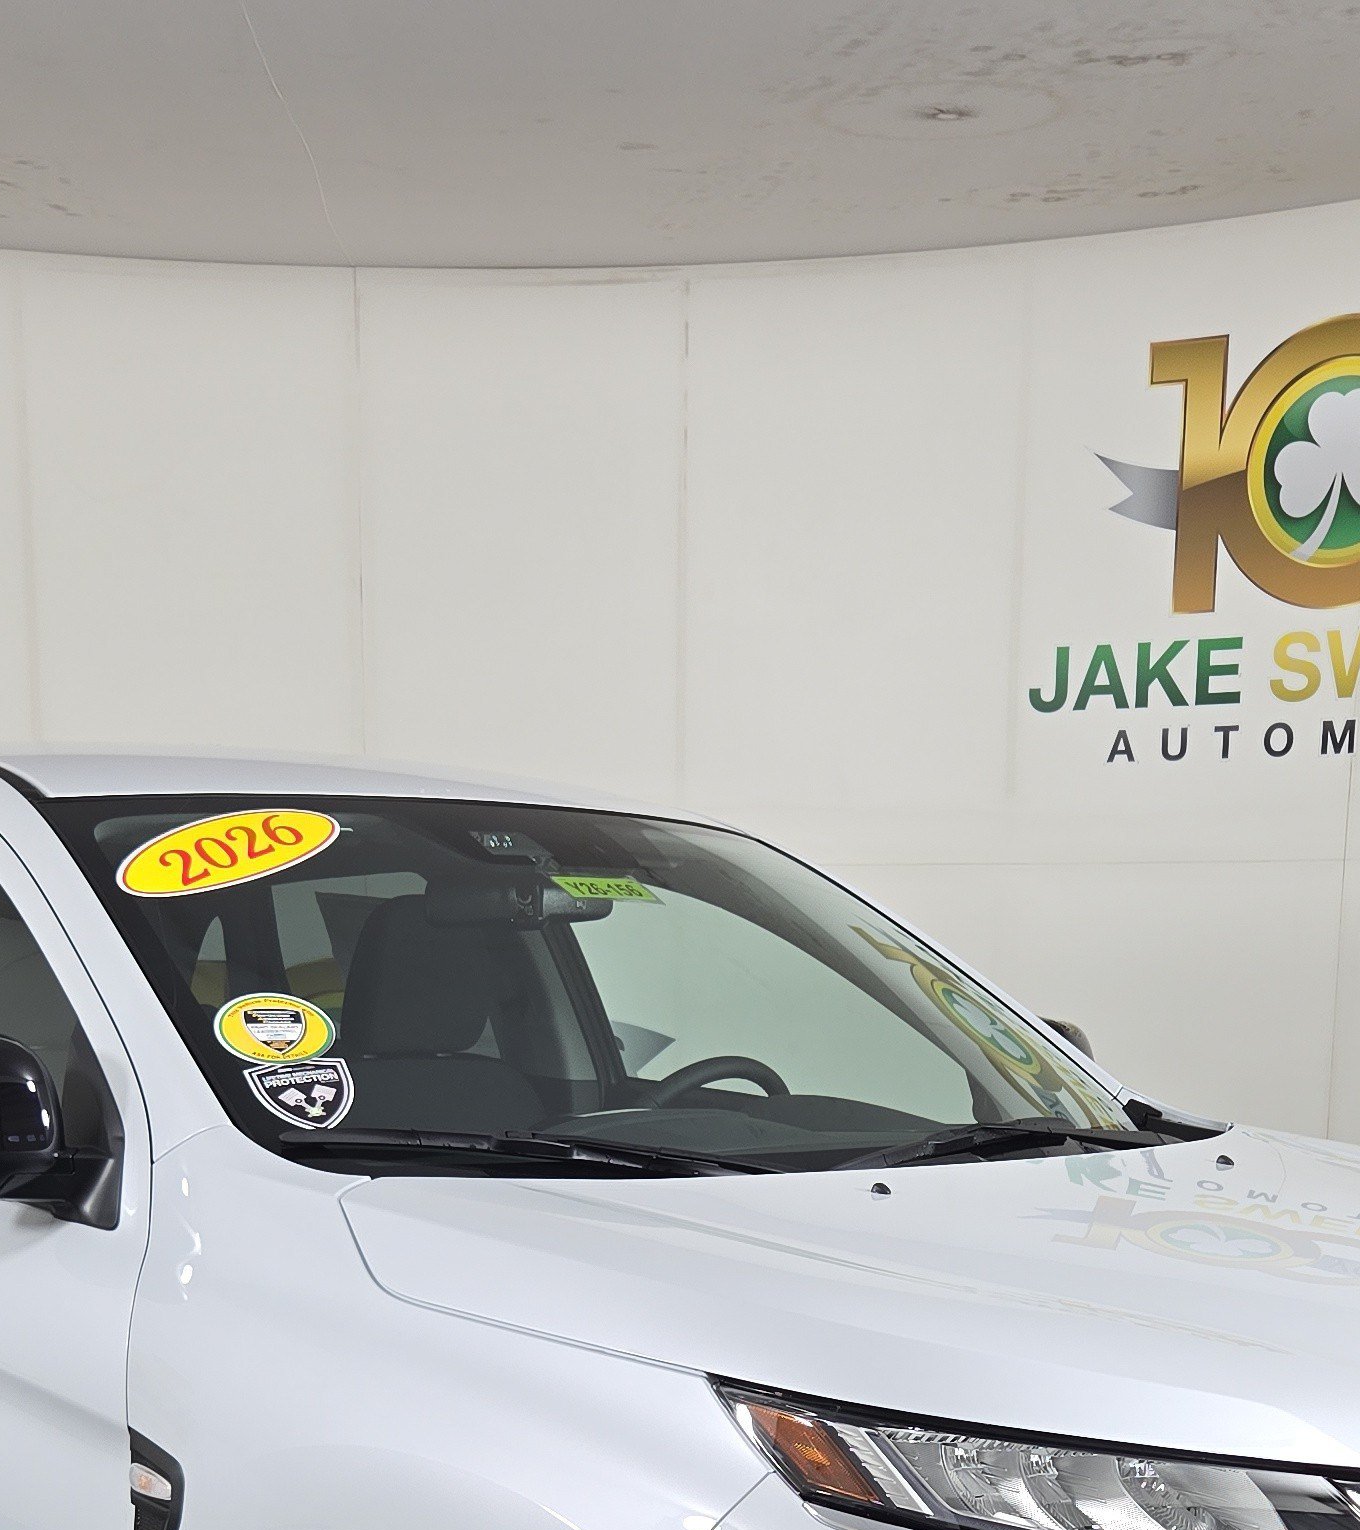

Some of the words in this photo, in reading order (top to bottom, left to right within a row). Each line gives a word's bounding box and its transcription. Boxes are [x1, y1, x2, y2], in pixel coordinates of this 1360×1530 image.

[1029, 636, 1243, 713] JAKE
[159, 815, 303, 886] 2026
[264, 1073, 339, 1089] PROTECTION
